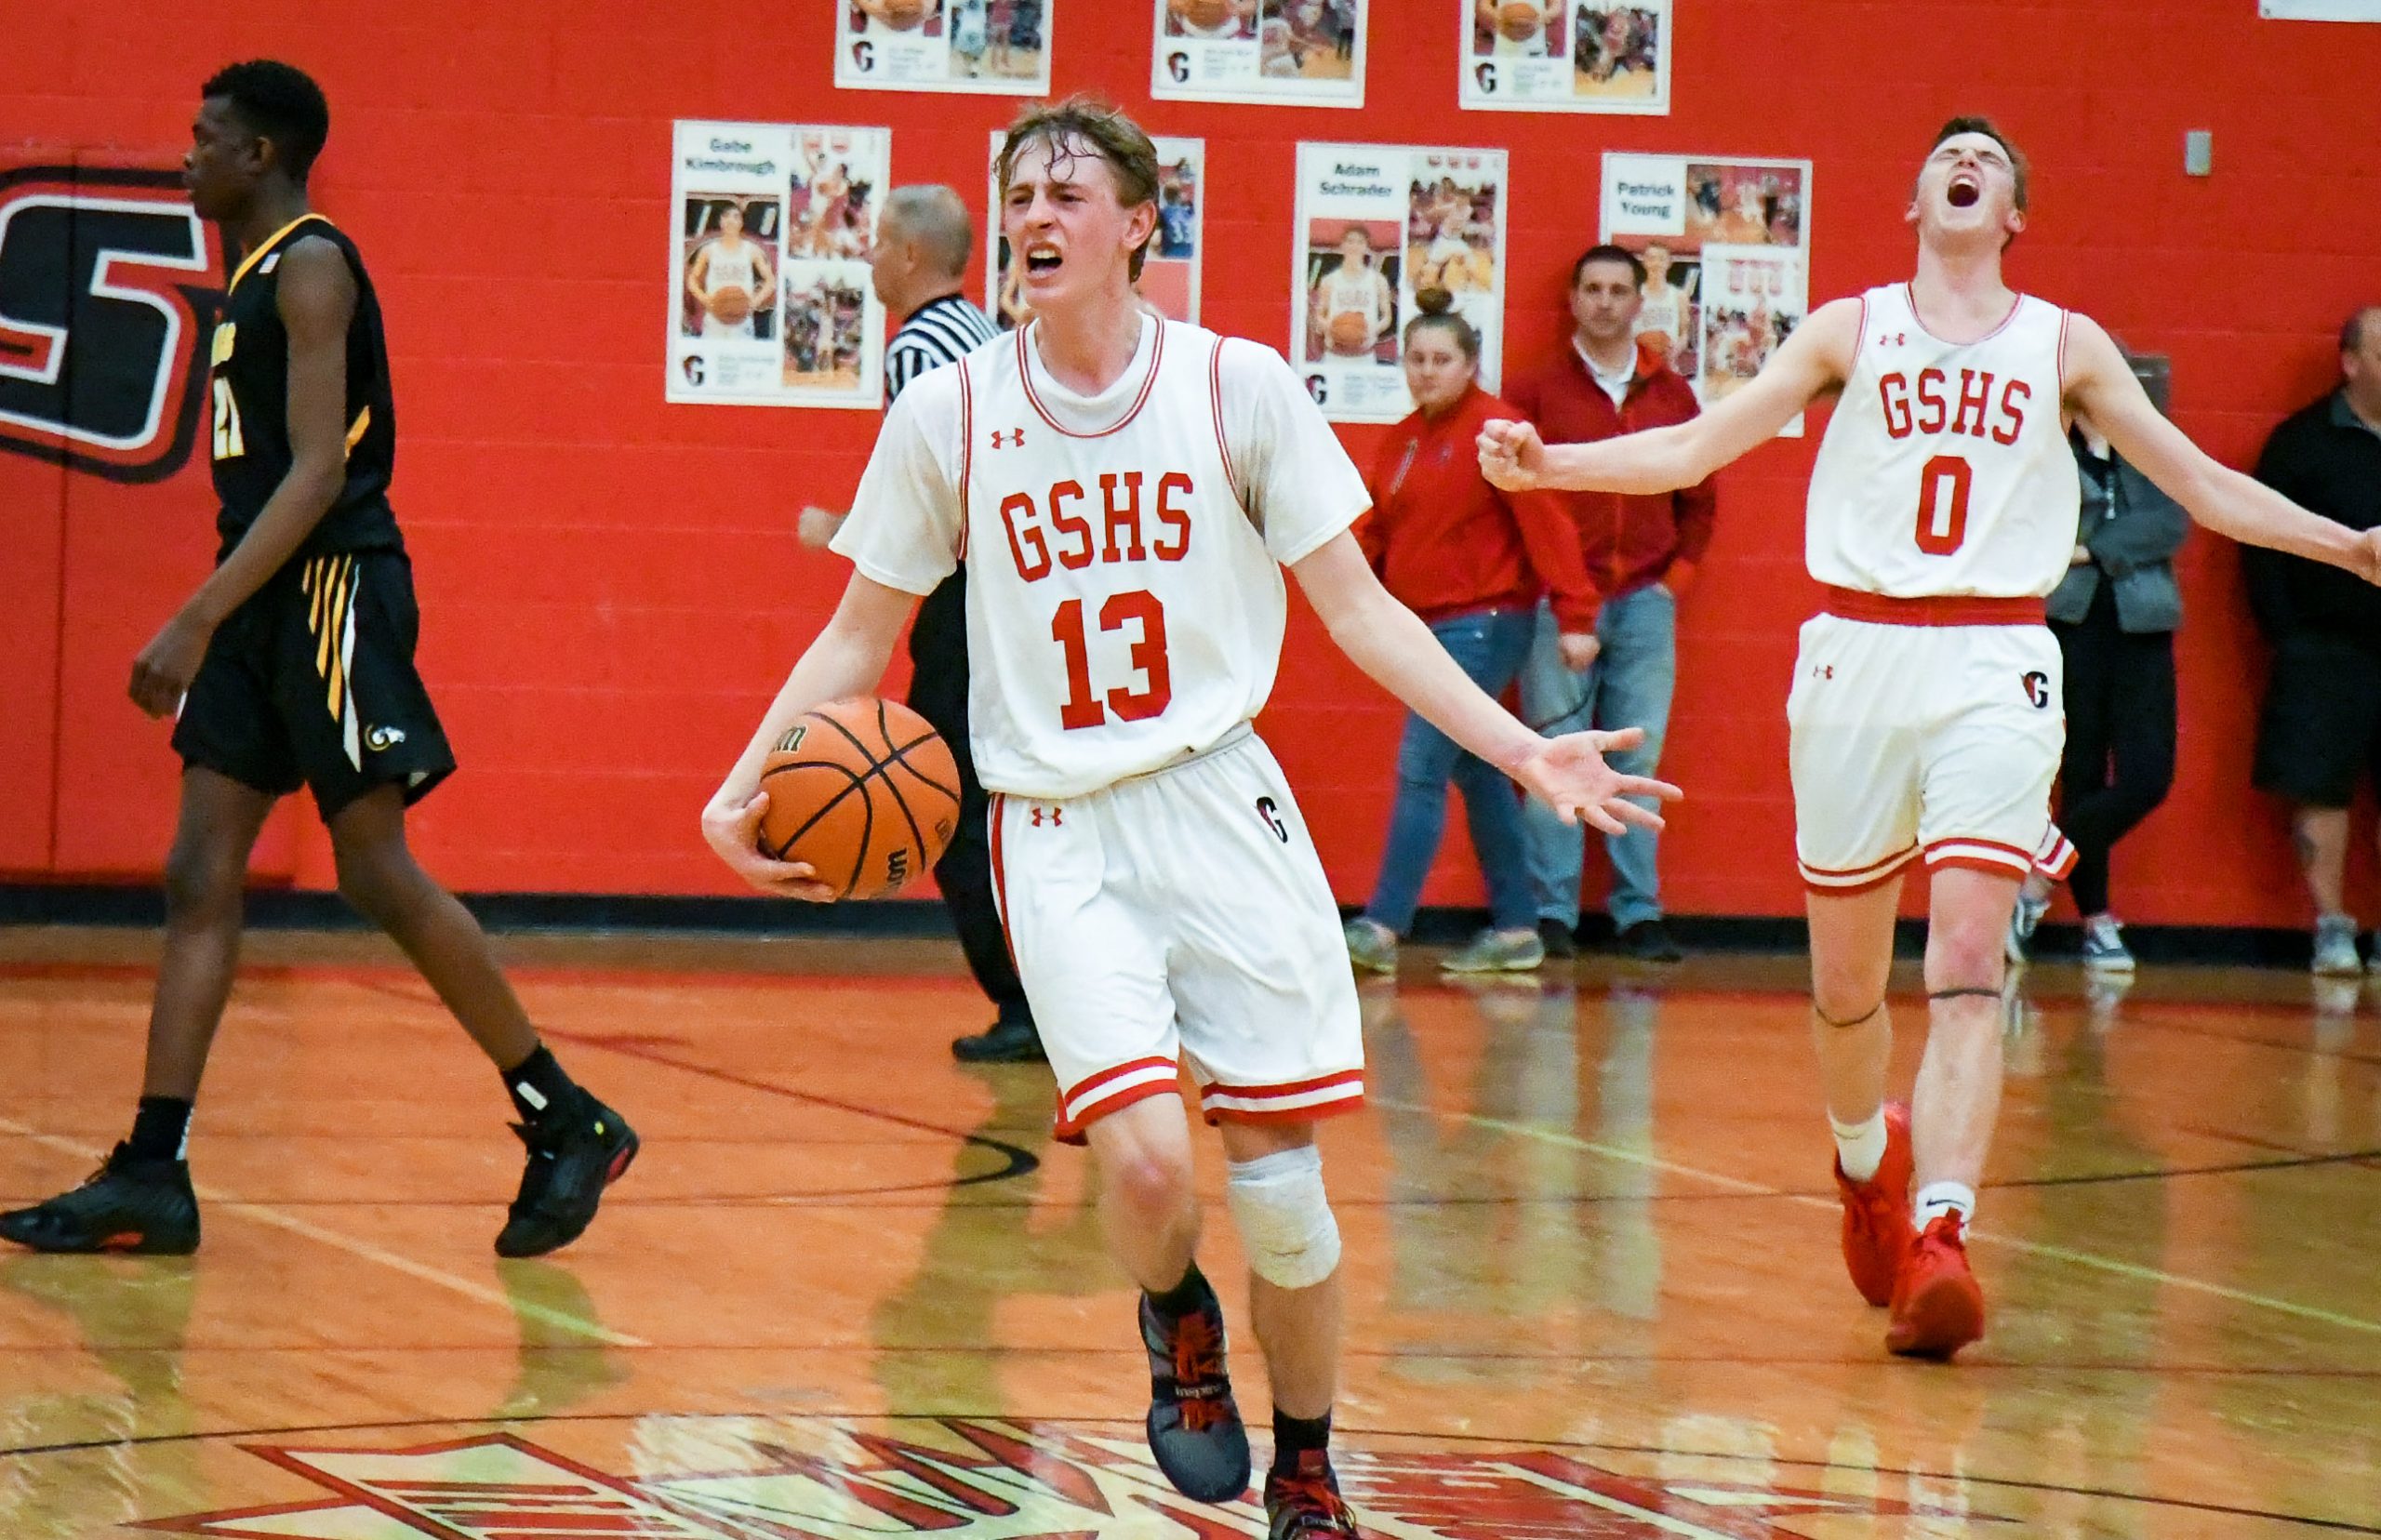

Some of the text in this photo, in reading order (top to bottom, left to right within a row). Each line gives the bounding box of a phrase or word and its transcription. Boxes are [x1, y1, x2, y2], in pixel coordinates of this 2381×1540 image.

[710, 138, 752, 153] Gabe
[1335, 163, 1380, 177] Adam
[1320, 181, 1392, 197] Schrader
[1618, 181, 1674, 197] Patrick
[1622, 201, 1671, 220] Young
[1880, 367, 2031, 446] GSHS
[1915, 455, 1972, 556] 0
[1000, 471, 1193, 583] GSHS
[1051, 589, 1172, 731] 13
